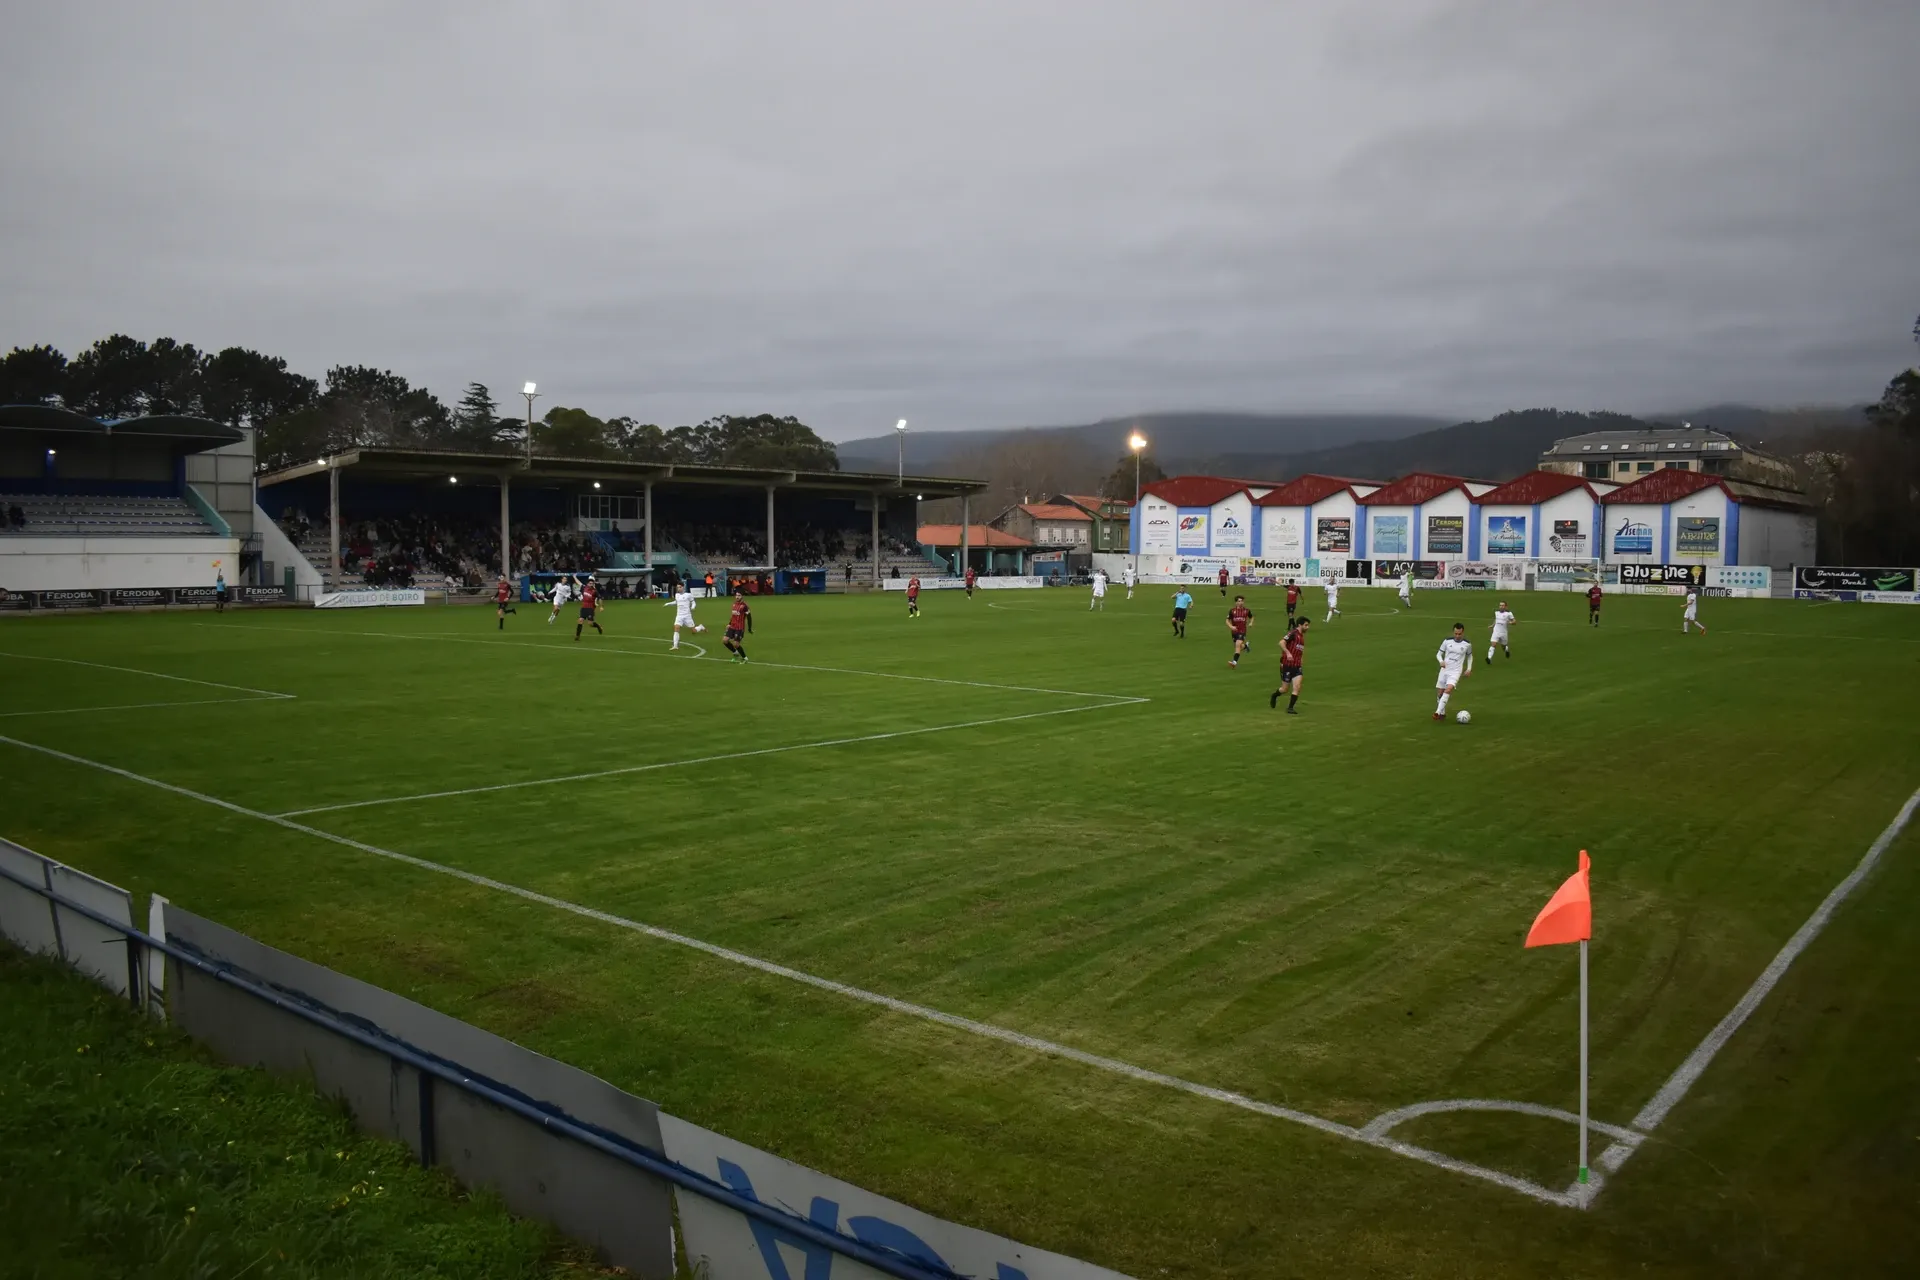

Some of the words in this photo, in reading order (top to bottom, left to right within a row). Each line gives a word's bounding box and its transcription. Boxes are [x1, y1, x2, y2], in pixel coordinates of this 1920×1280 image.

[1255, 560, 1301, 570] Moreno
[1320, 570, 1344, 578] BOIRO
[1539, 566, 1575, 574] VRUMA
[1624, 565, 1688, 580] aluzine
[46, 591, 94, 600] FERDOBA
[116, 589, 161, 598] FERDOBA
[181, 588, 217, 596] FERDOB
[245, 587, 284, 595] FERDOBA
[337, 594, 378, 605] ONCELLO
[392, 593, 419, 602] BOIRO
